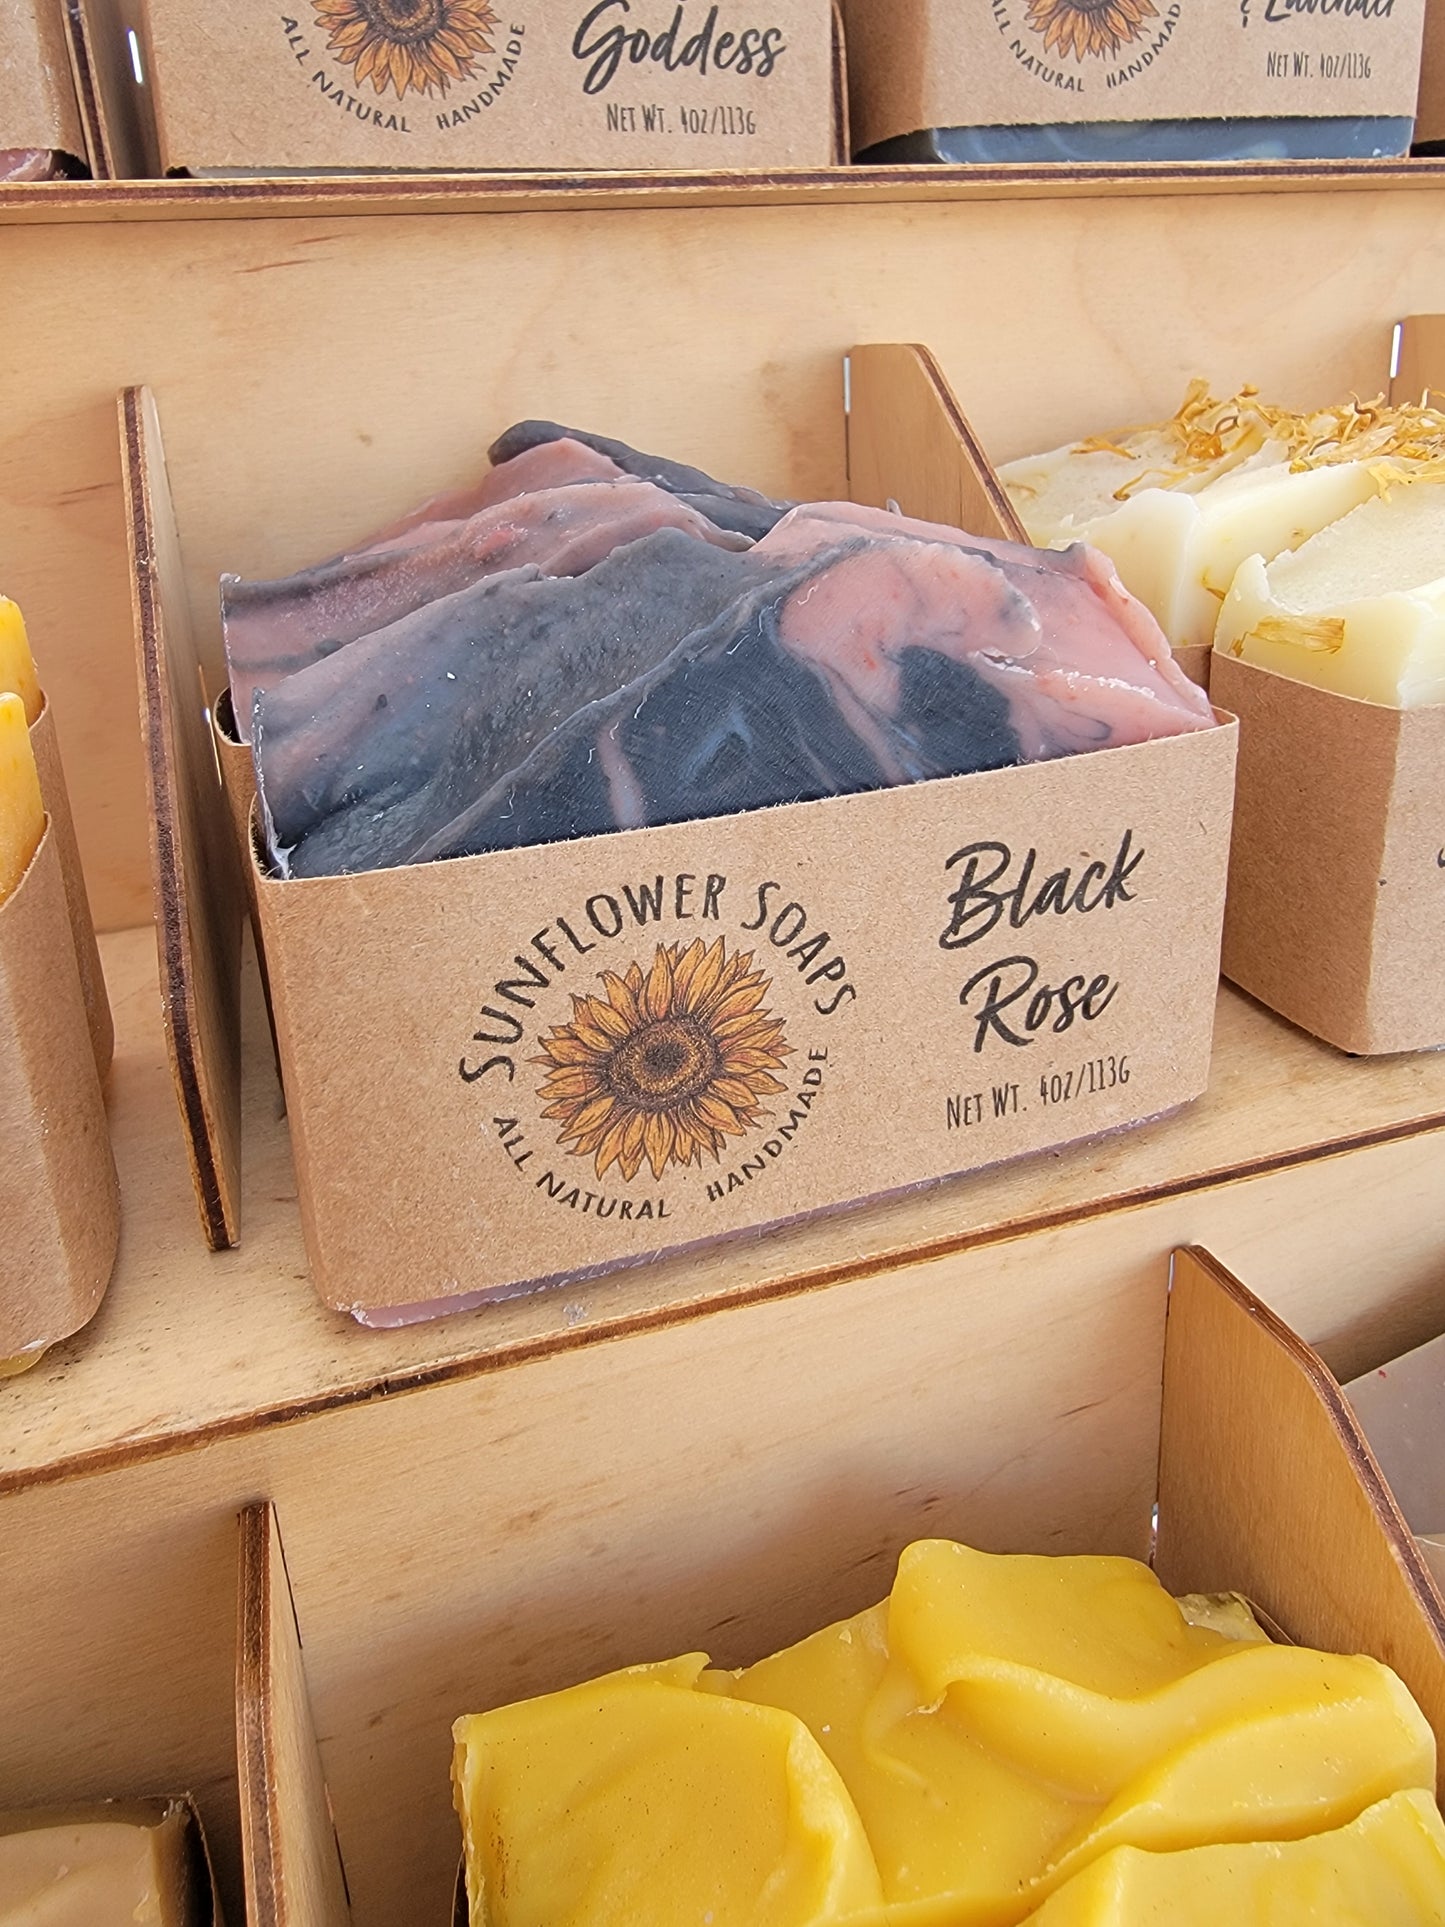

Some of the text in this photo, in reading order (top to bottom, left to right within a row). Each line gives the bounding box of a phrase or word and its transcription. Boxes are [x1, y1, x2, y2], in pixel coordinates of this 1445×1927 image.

[280, 15, 526, 133] ALL NATURAL HANDMADE
[572, 0, 787, 95] Goddess
[1009, 39, 1085, 92] NATURAL
[1106, 3, 1182, 88] HANDMAD
[1266, 51, 1289, 78] NET
[606, 103, 636, 132] NET
[938, 828, 1146, 950] Black
[459, 873, 858, 1084] SUNFLOWER SOAPS
[959, 955, 1119, 1053] Rose
[492, 1046, 829, 1220] ALL NATURAL HANDMADE
[946, 1094, 983, 1130] NET
